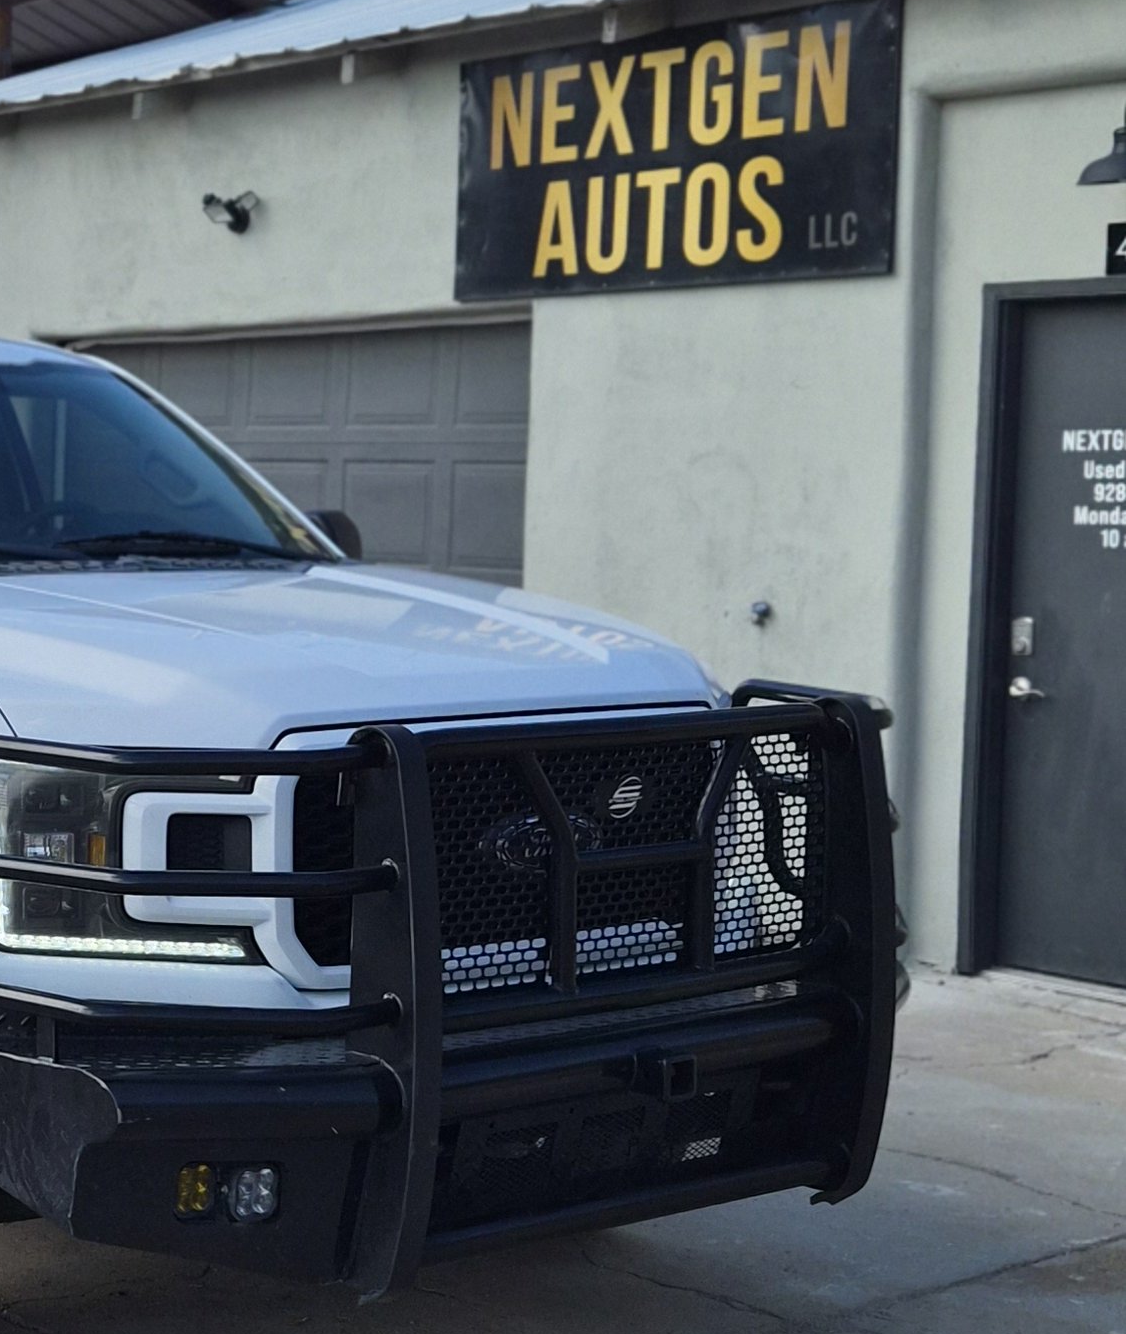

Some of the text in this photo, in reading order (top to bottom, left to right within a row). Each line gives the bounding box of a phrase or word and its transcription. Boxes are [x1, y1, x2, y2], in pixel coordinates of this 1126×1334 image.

[489, 20, 852, 171] NEXTGEN
[532, 155, 859, 278] AUTOS LLC
[1062, 429, 1126, 452] NEXTG
[1083, 460, 1126, 479] Used
[1100, 528, 1120, 548] 10
